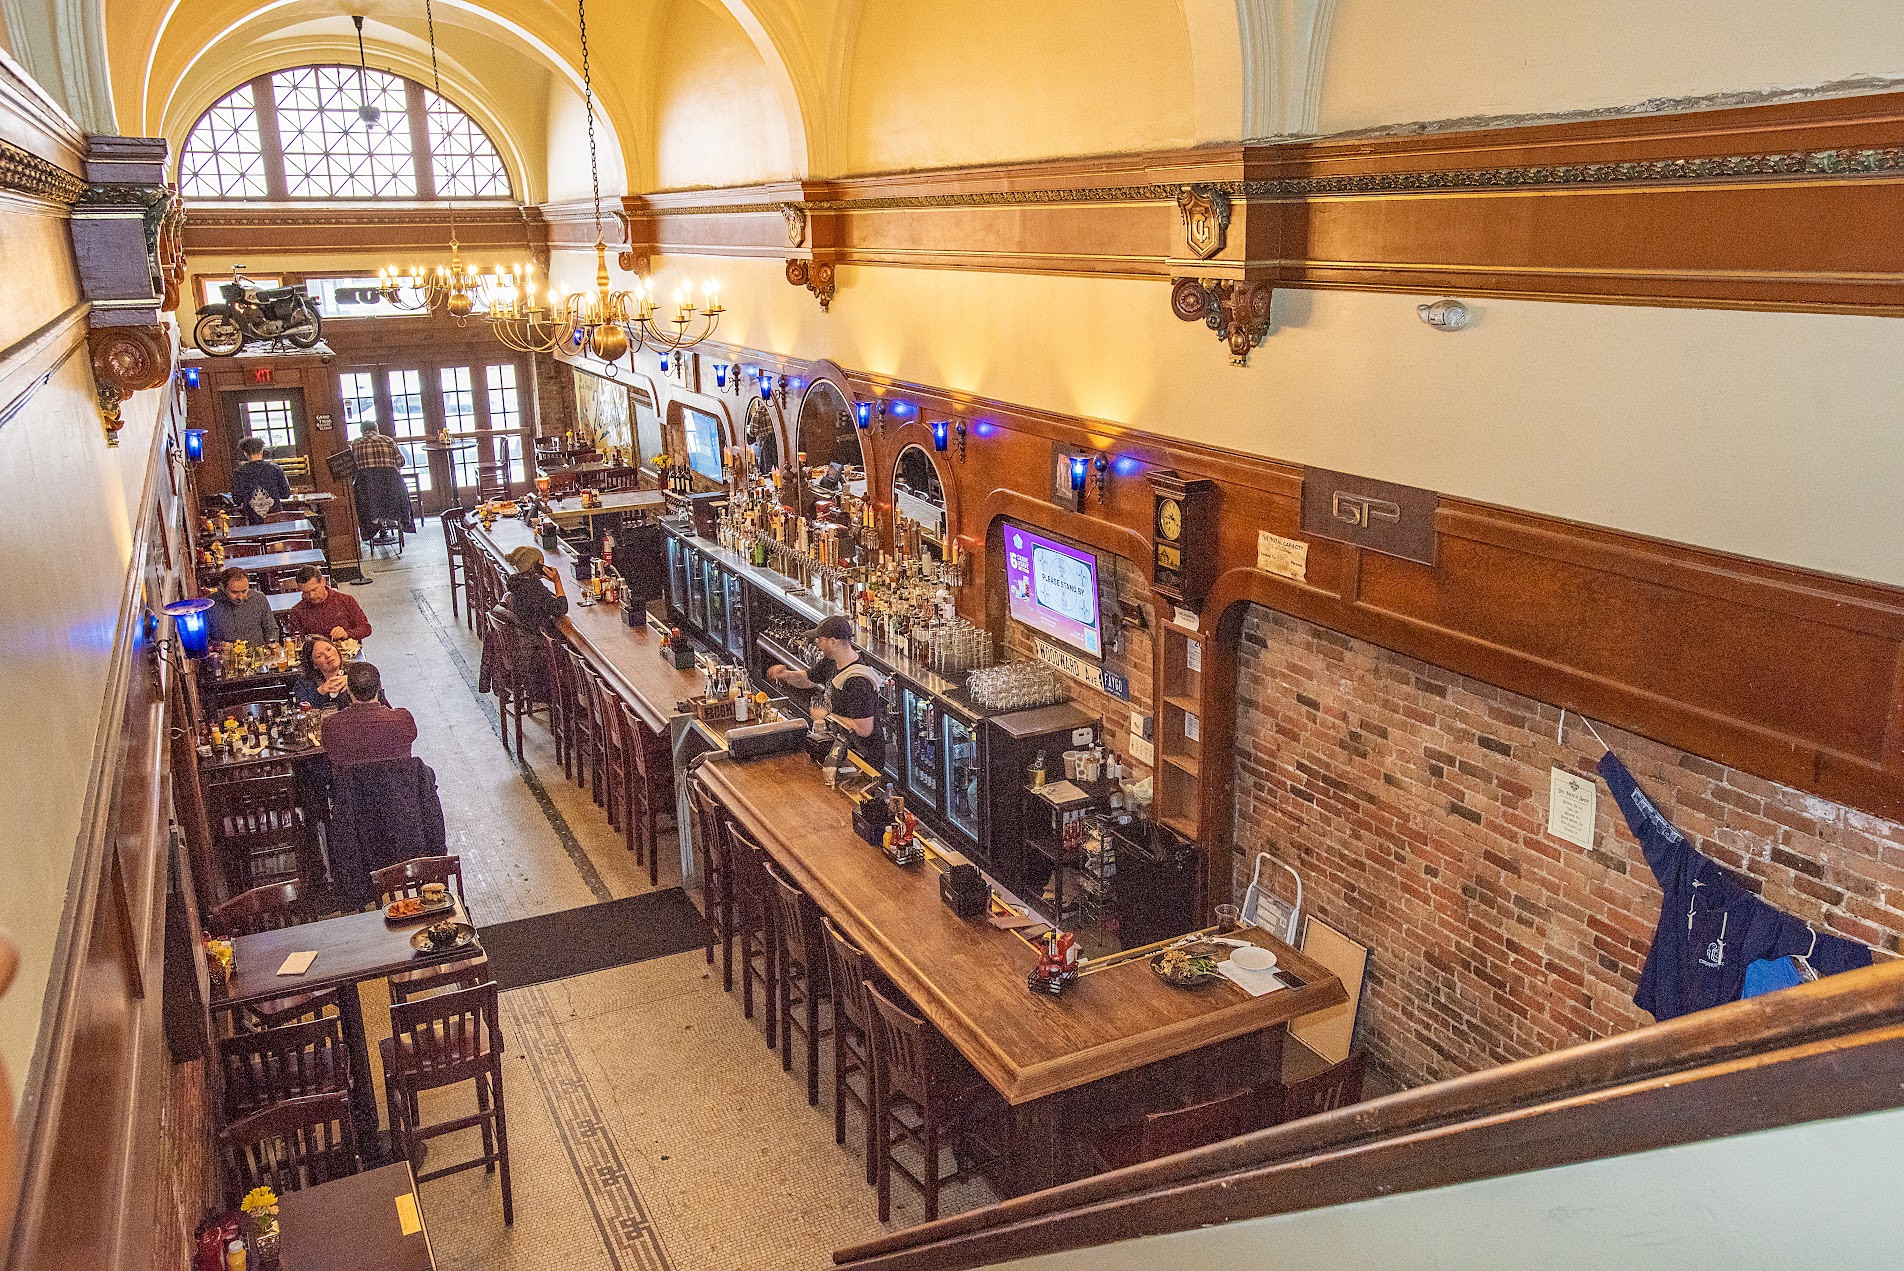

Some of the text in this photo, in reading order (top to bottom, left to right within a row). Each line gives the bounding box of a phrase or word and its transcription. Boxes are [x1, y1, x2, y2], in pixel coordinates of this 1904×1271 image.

[1282, 541, 1304, 551] CAPACITY
[1042, 573, 1085, 596] PLEASE STAND BY
[1040, 643, 1080, 677] WOODWARD
[1104, 673, 1123, 693] FAYGO
